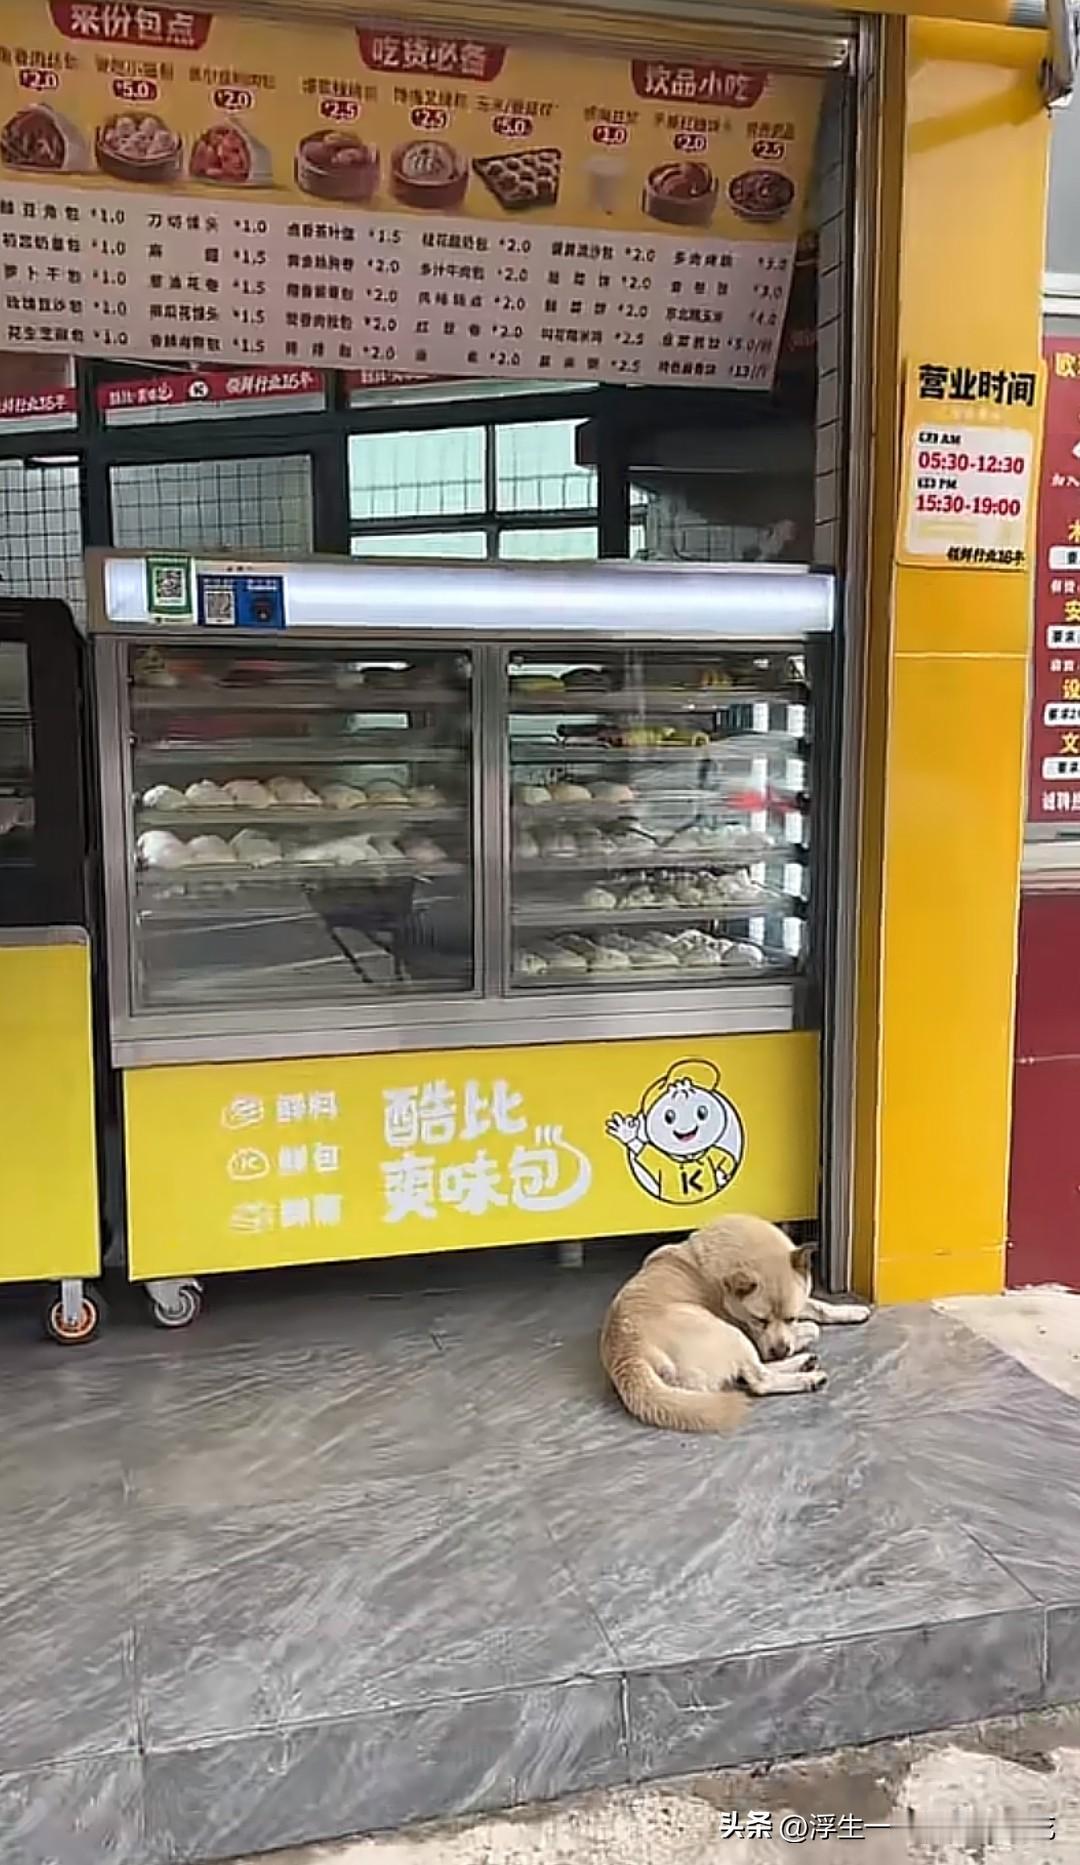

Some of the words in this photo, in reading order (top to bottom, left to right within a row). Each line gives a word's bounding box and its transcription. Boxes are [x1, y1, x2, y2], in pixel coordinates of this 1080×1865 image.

[645, 64, 754, 100] 饮品小吃
[148, 213, 219, 232] 刀切馒头
[918, 364, 1036, 406] 营业时间
[918, 451, 1024, 475] 05:30-12:30
[916, 494, 1021, 516] 15:30-19:00
[382, 1080, 528, 1148] 酷比
[380, 1125, 592, 1222] 爽味包
[681, 1169, 704, 1195] K
